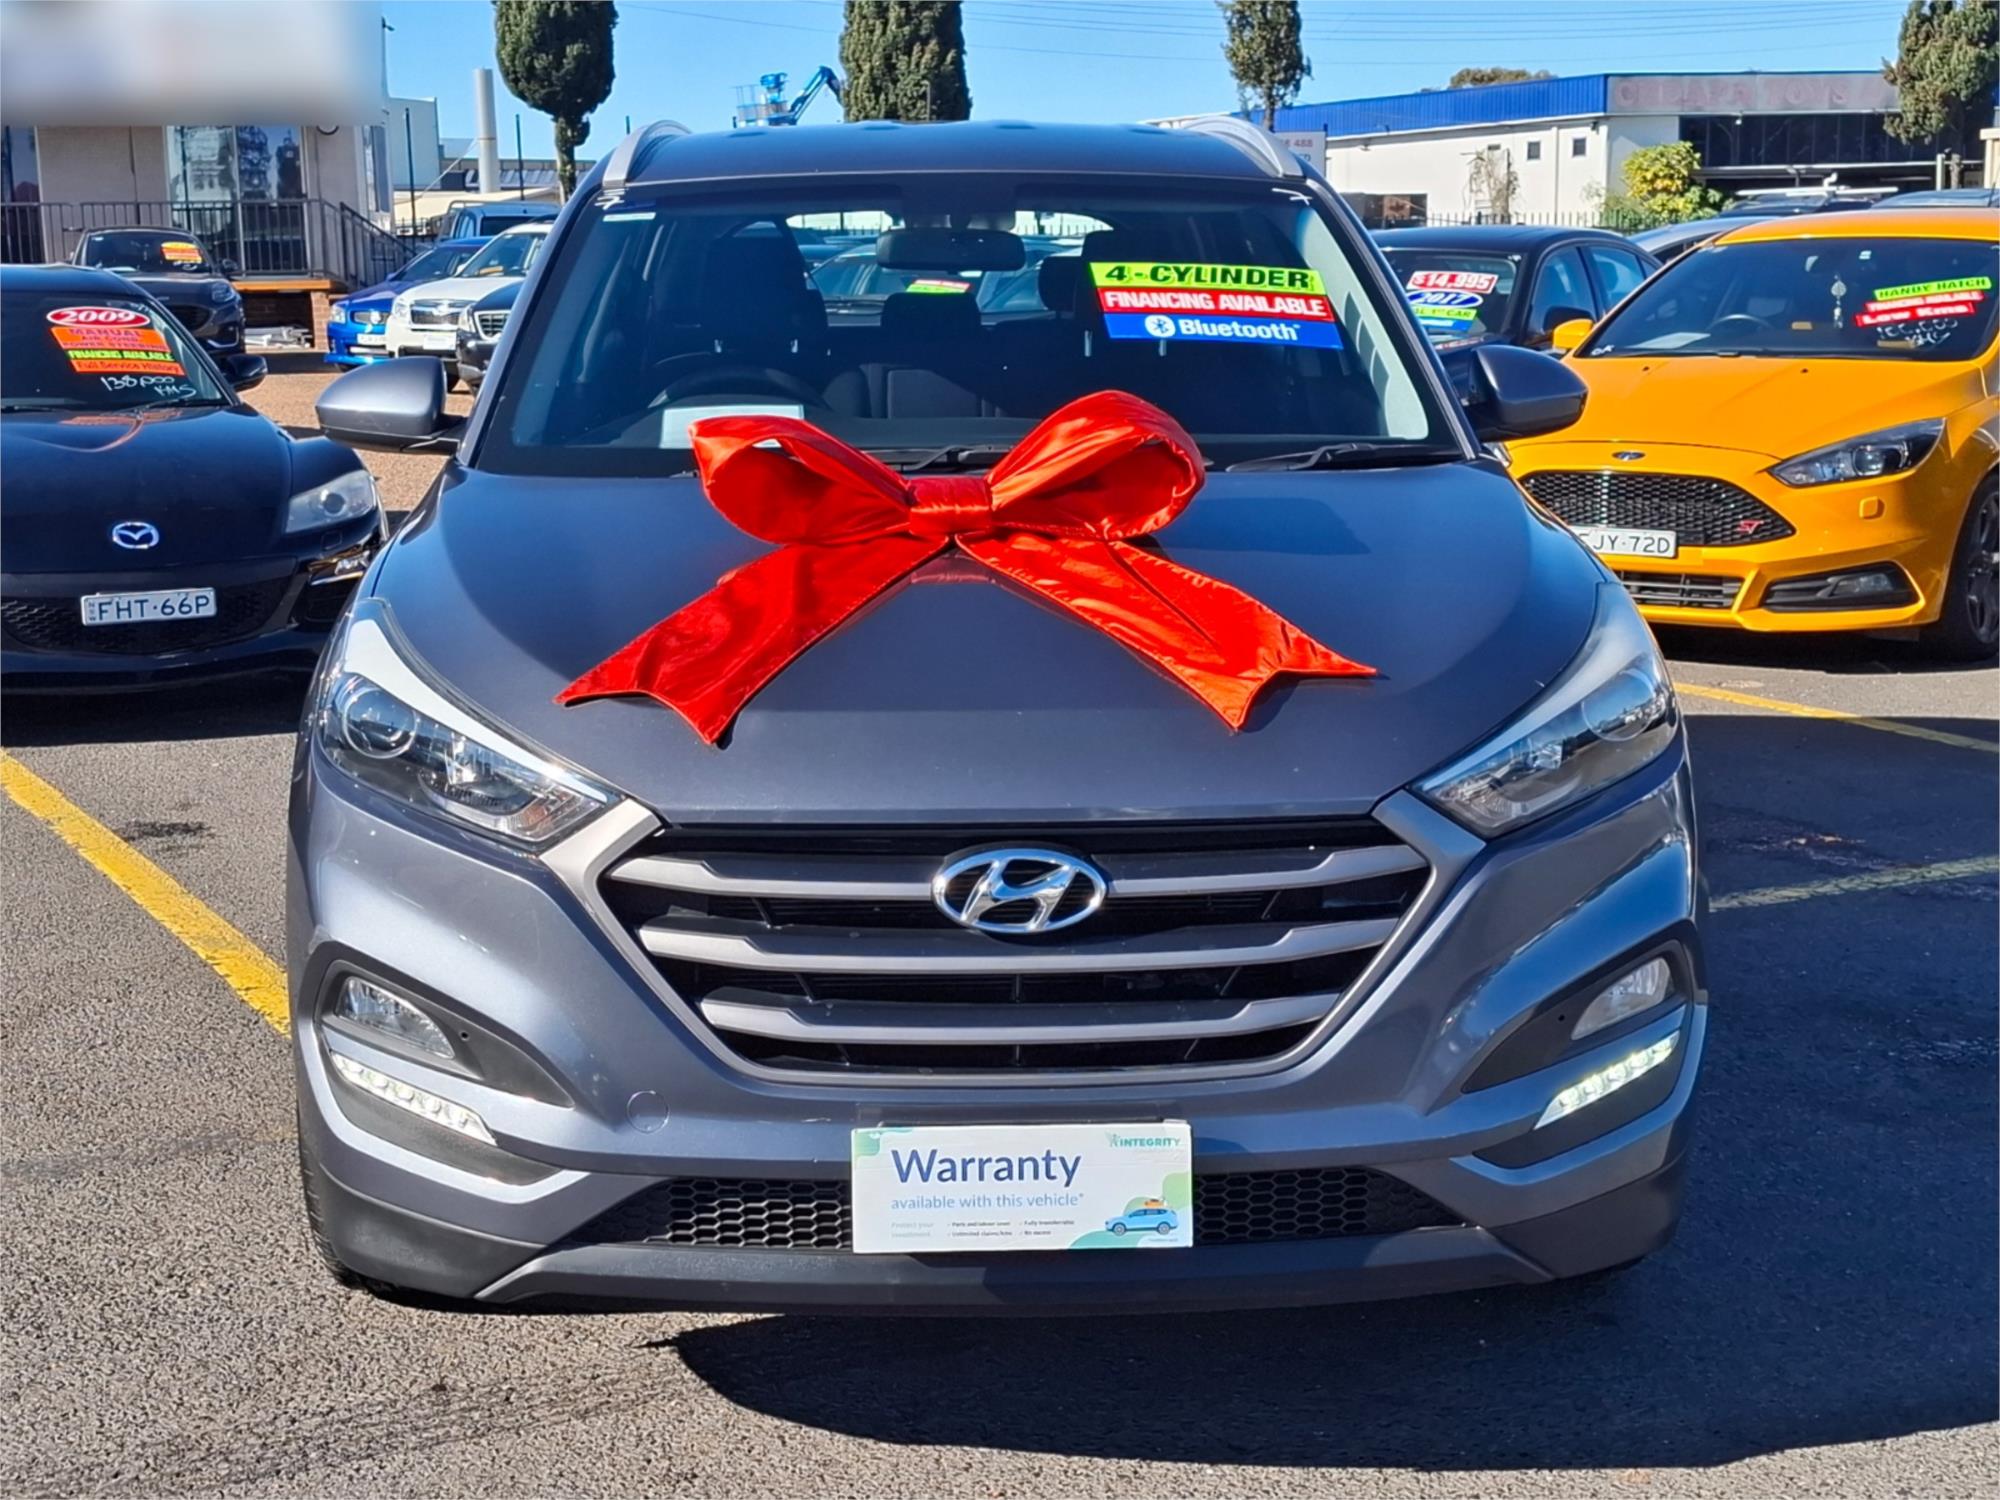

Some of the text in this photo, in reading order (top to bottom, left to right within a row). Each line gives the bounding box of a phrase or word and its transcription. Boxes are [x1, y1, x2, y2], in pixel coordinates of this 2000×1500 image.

[1105, 264, 1312, 289] 4-CYLINDER
[1879, 278, 1986, 298] HANDY HATCH
[1104, 290, 1328, 317] FINANCING AVAILABLE
[60, 310, 136, 323] 2009
[69, 328, 142, 337] MANUAL
[1119, 1137, 1181, 1147] INTEGRITY
[890, 1148, 1082, 1188] Warranty
[891, 1194, 955, 1209] available
[959, 1194, 992, 1208] with
[996, 1193, 1023, 1207] this
